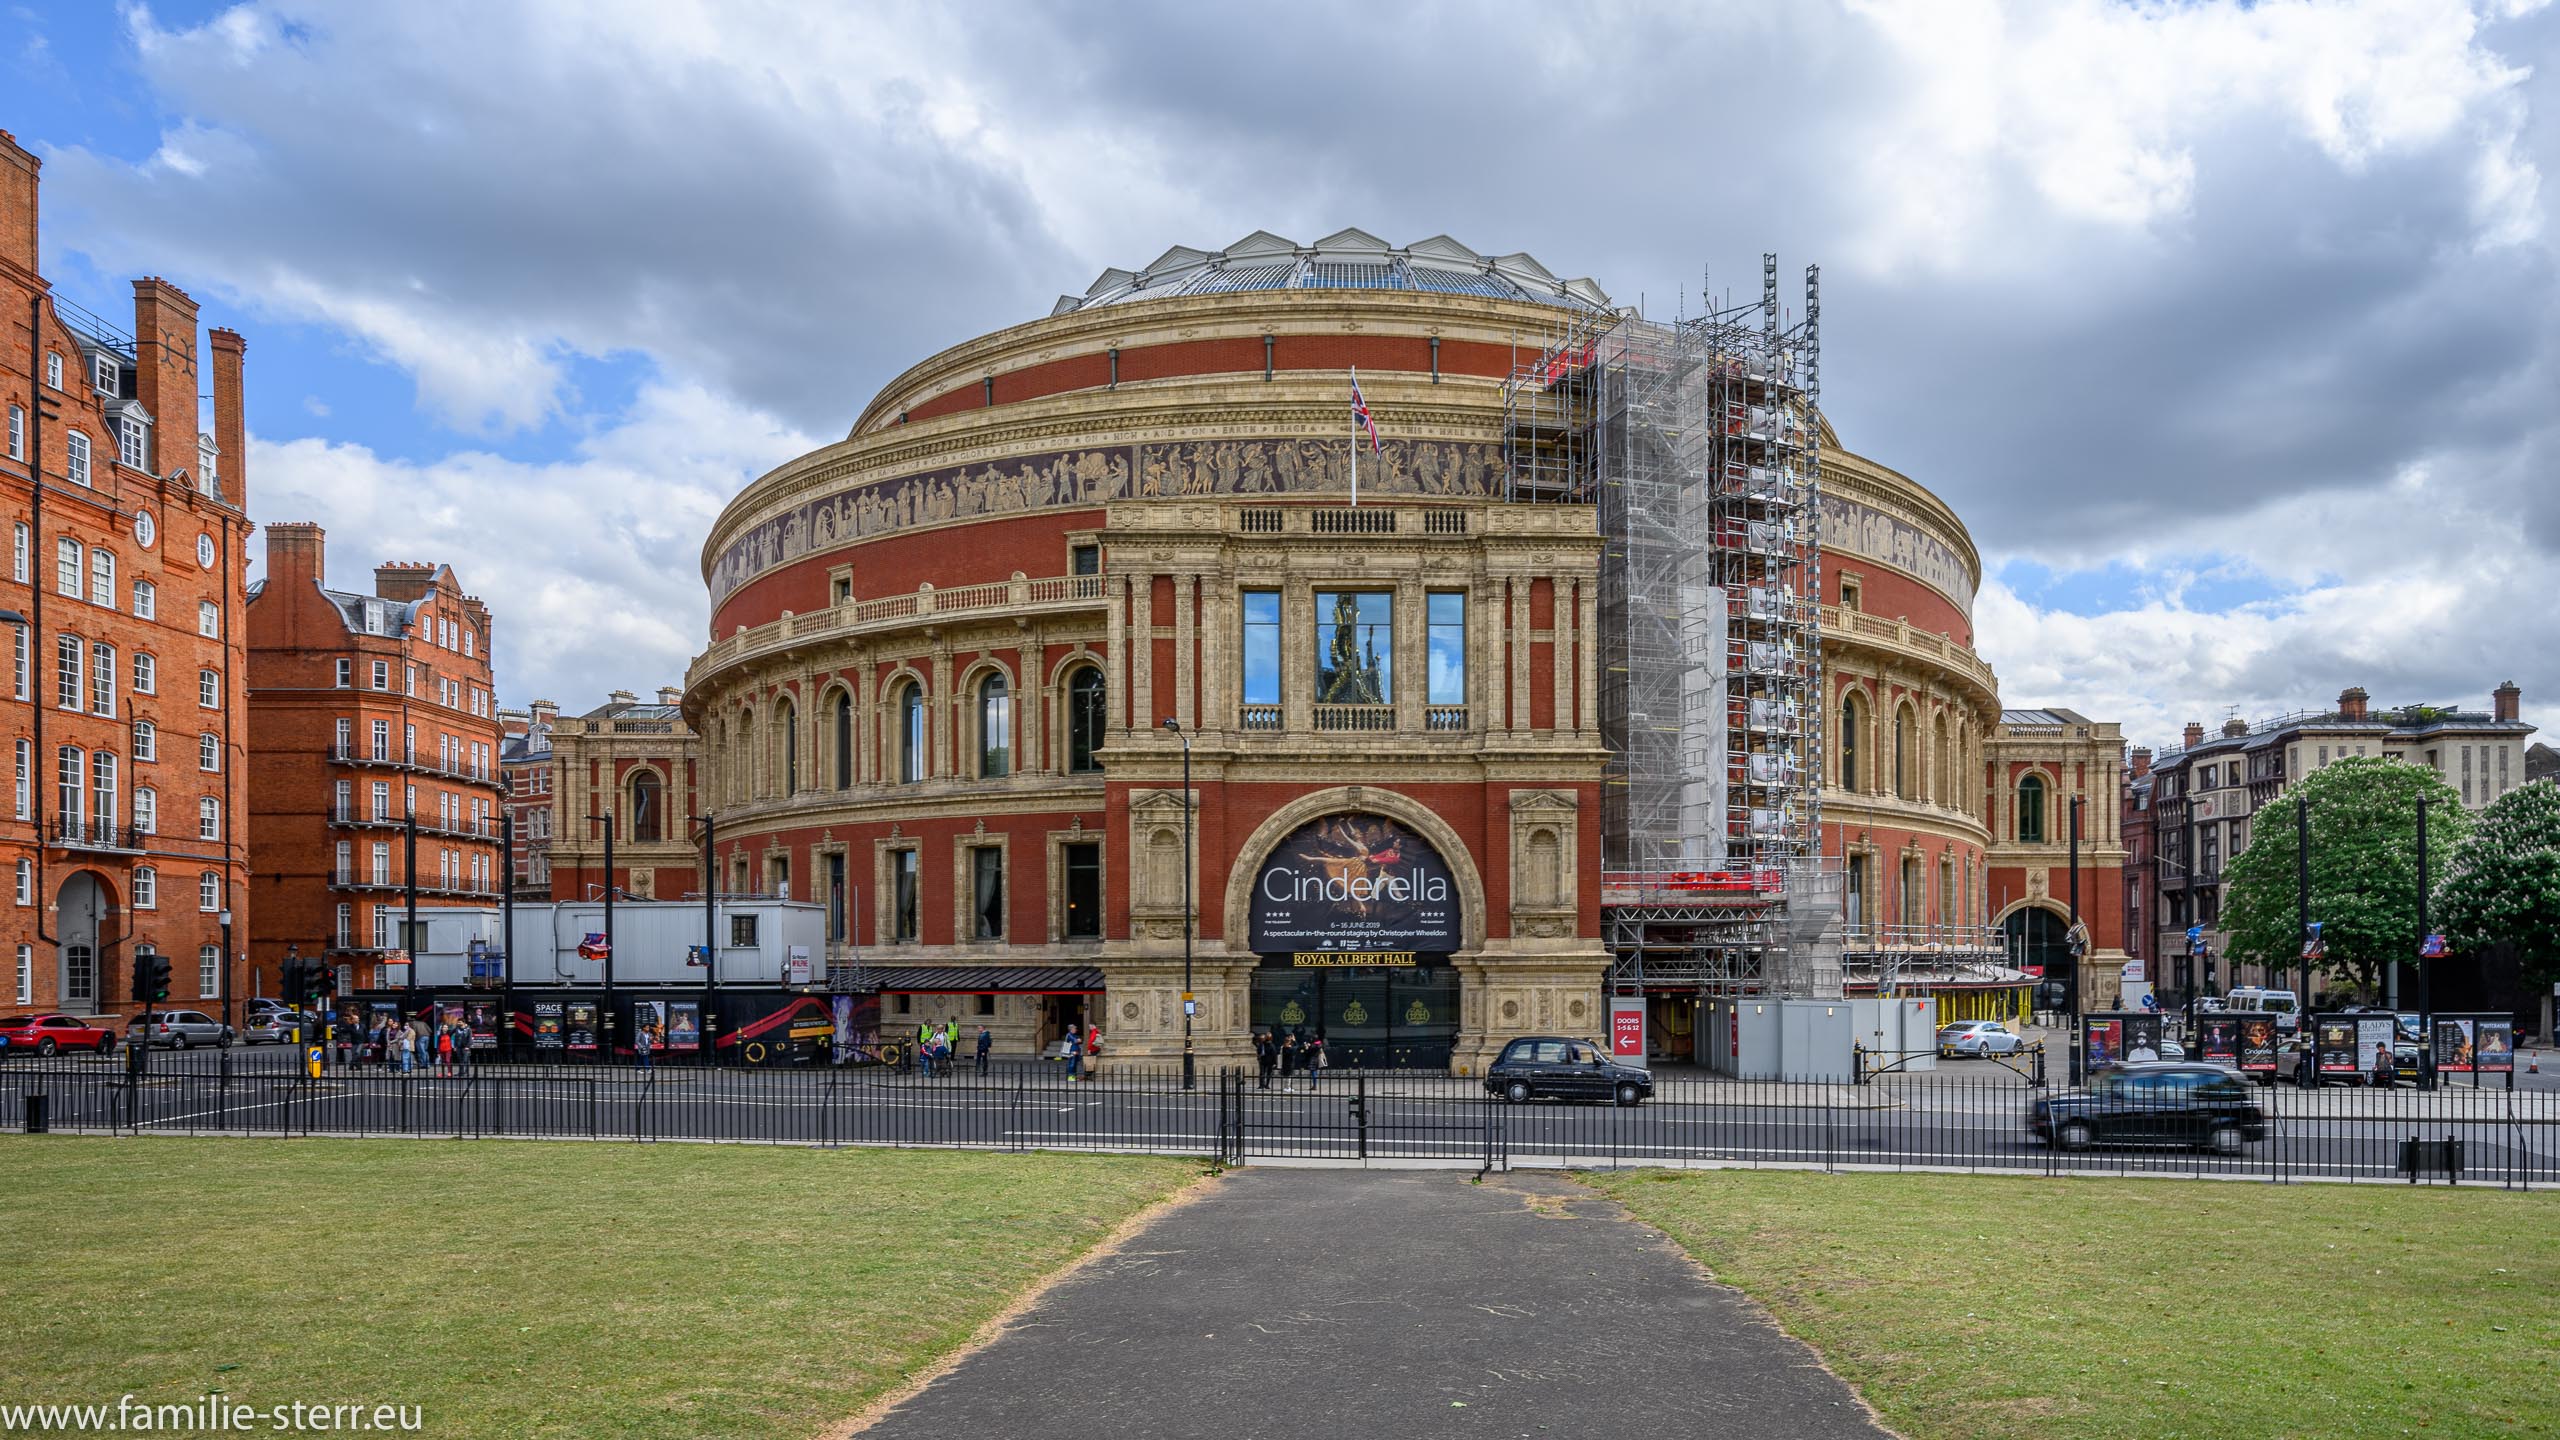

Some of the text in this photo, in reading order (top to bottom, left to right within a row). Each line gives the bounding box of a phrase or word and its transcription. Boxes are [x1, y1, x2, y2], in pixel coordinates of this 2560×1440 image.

[931, 455, 948, 465] GOD
[960, 448, 988, 460] GLORY
[1023, 442, 1036, 450] TO
[1113, 431, 1138, 441] HIGH
[1153, 430, 1175, 438] AND
[1192, 428, 1205, 436] ON
[1222, 426, 1256, 434] EARTH
[1273, 425, 1306, 433] PEACE
[1400, 426, 1423, 435] THIS
[1440, 428, 1465, 437] HALL
[1264, 867, 1447, 902] Cinderella
[1270, 930, 1305, 938] spectacular
[1306, 929, 1346, 937] in-the-round
[1347, 930, 1370, 938] staging
[1370, 929, 1378, 938] by
[1379, 929, 1415, 938] Christopher
[1416, 929, 1447, 937] Wheeldon
[1294, 954, 1416, 965] ROYAL ALBERT HALL
